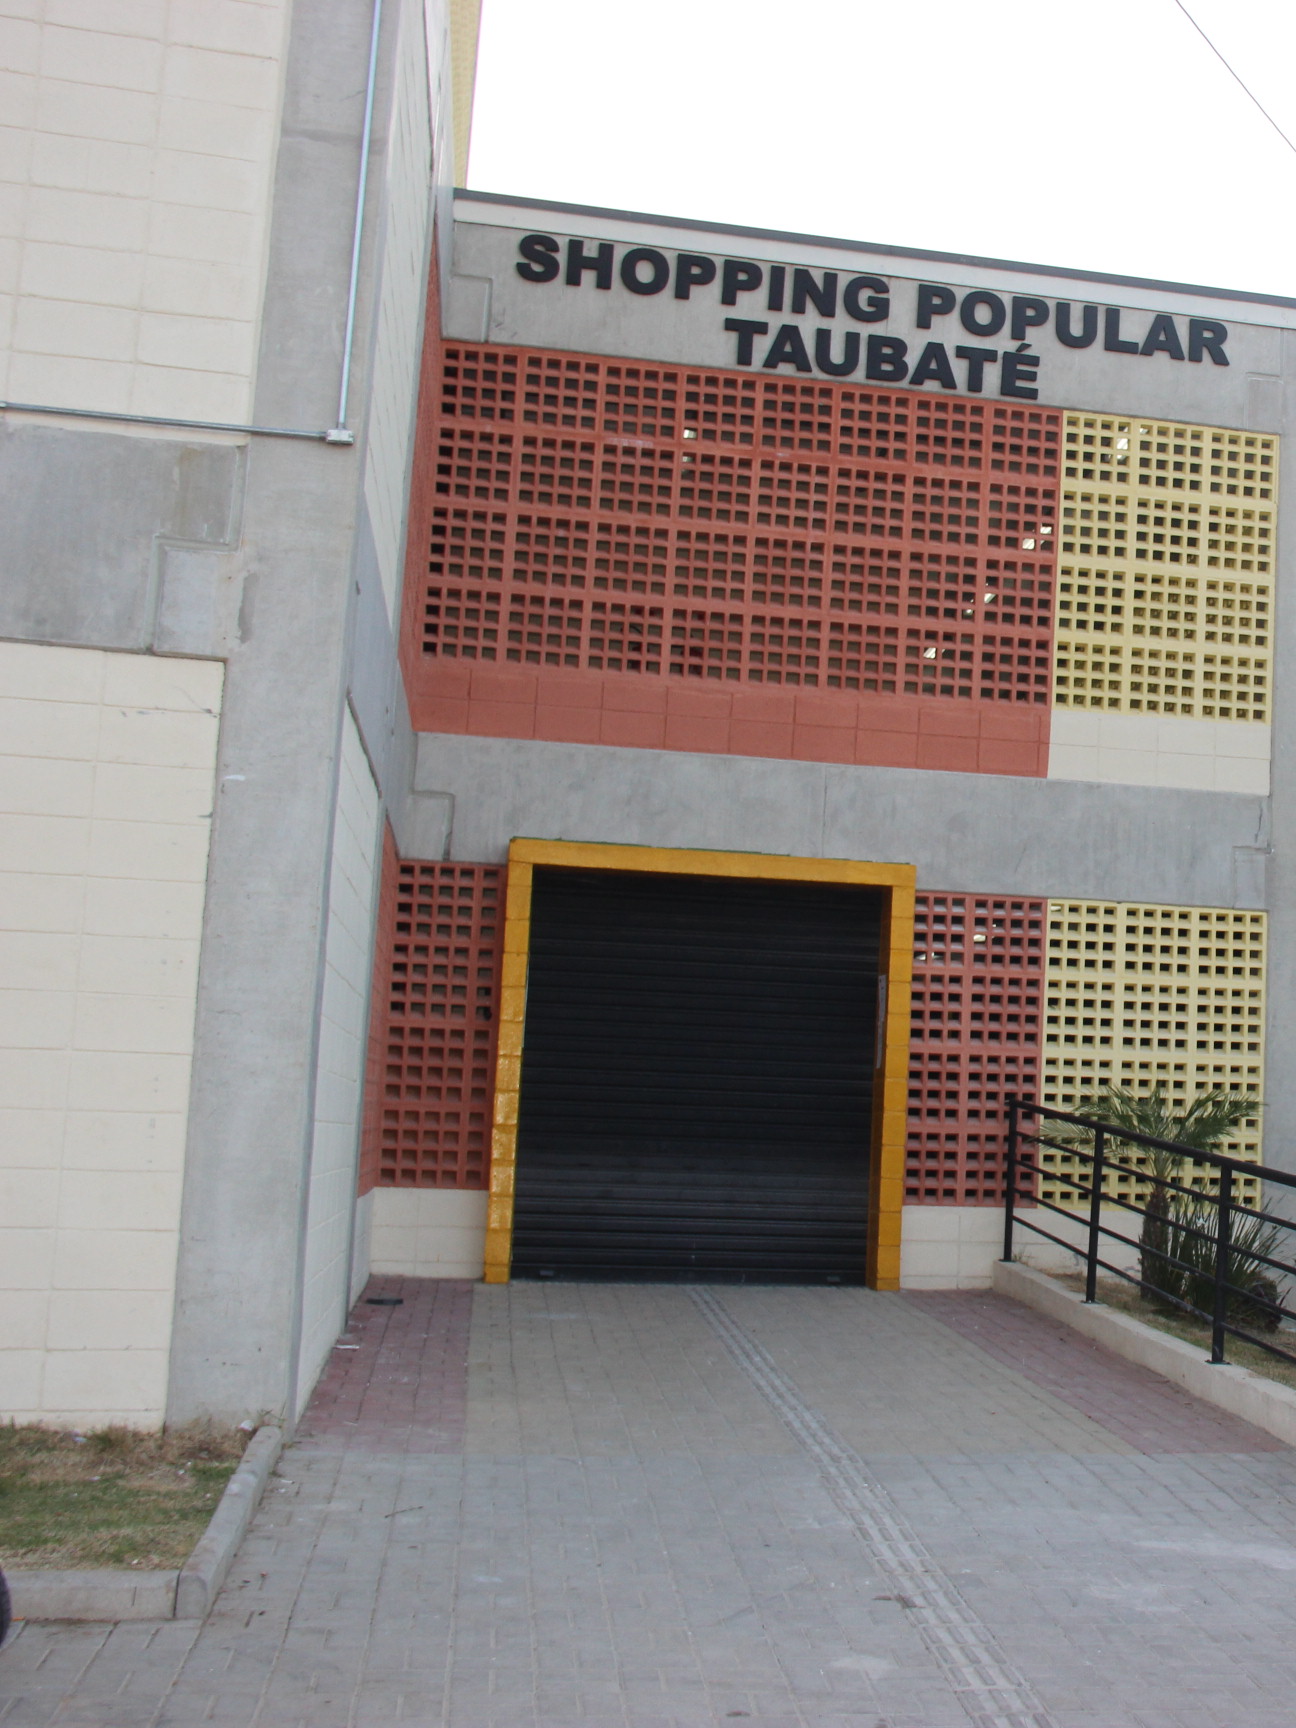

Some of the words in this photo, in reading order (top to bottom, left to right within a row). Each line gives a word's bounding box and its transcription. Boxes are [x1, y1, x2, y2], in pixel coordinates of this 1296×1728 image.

[516, 233, 890, 323] SHOPPING
[916, 283, 1230, 366] POPULAR
[725, 318, 1040, 400] TAUBATÉ
